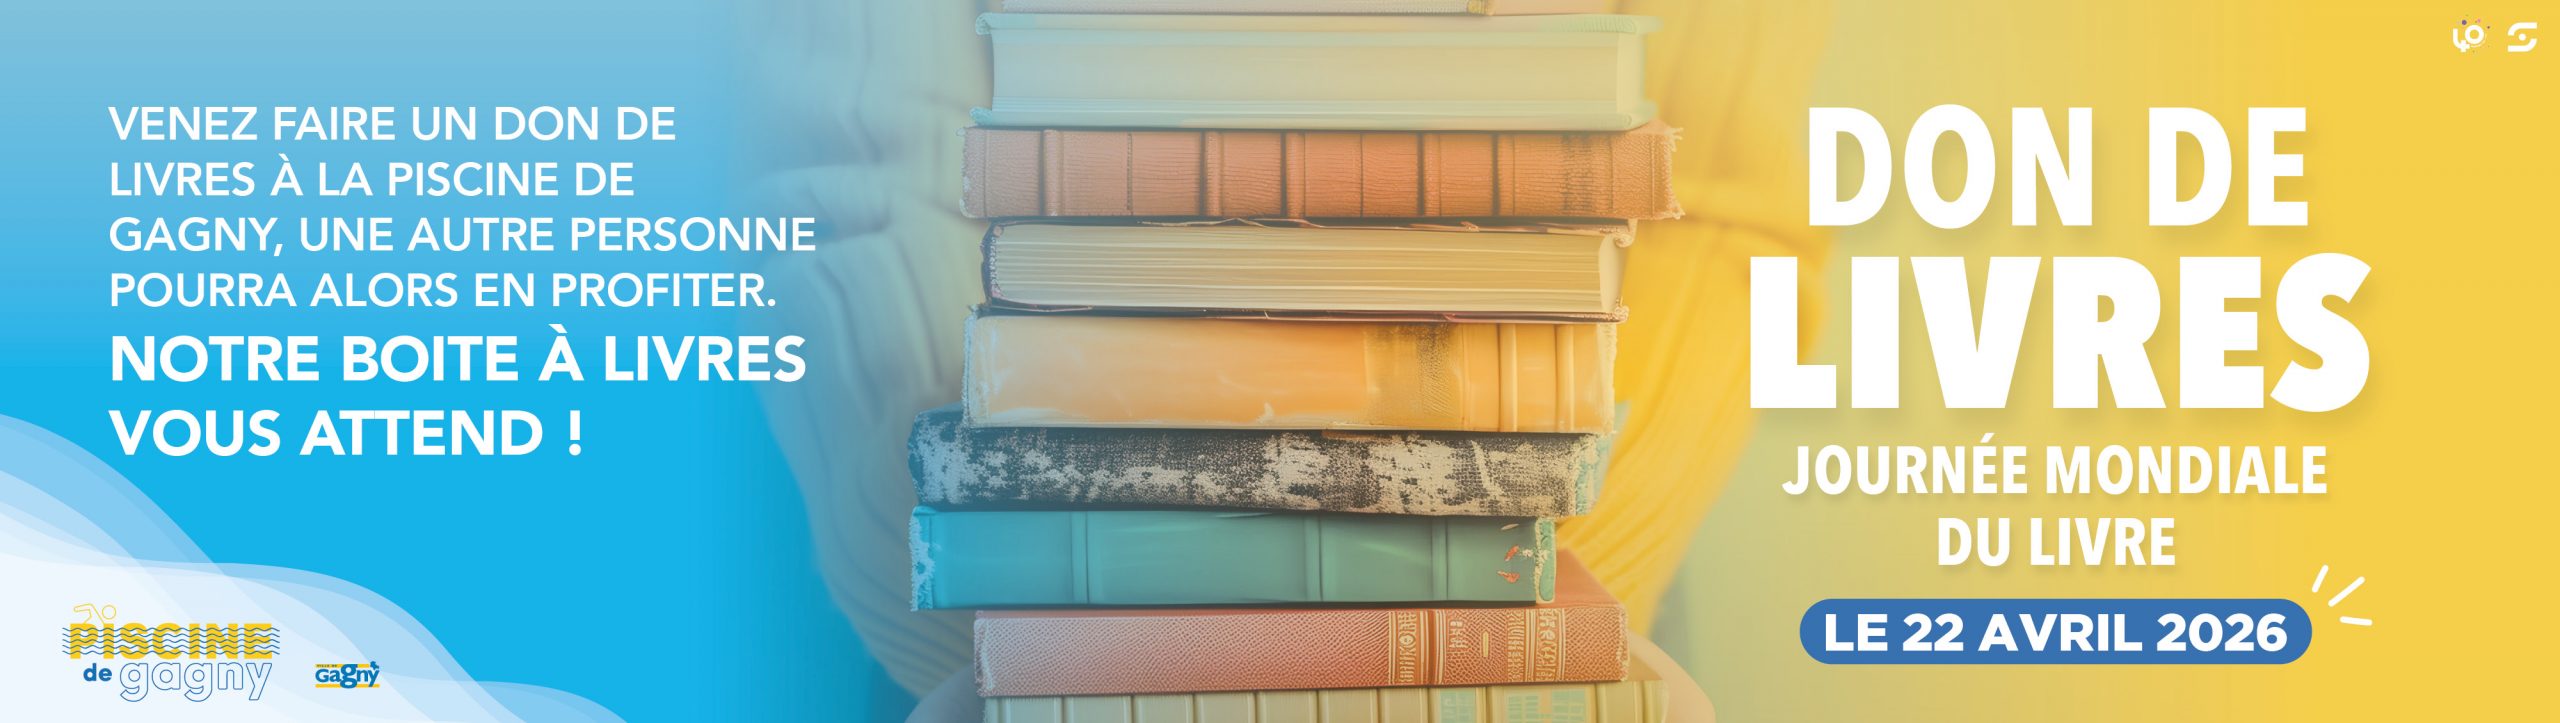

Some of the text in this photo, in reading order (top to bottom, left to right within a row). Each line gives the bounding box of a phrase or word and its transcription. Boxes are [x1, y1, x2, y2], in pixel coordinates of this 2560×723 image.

[108, 105, 676, 141] VENEZ FAIRE UN DON DE
[111, 153, 634, 197] LIVRES À LA PISCINE DE
[1809, 104, 2308, 229] DON DE
[109, 216, 816, 257] GAGNY, UNE AUTRE PERSONNE
[111, 272, 776, 307] POURRA ALORS EN PROFITER.
[112, 323, 806, 383] NOTRE BOITE À LIVRES
[1750, 253, 2370, 412] LIVRES
[108, 409, 581, 457] VOUS ATTEND !
[1782, 432, 2327, 495] JOURNÉE MONDIALE
[1938, 517, 2175, 566] DU LIVRE
[70, 623, 272, 659] PISCINE
[1825, 613, 2287, 652] LE 22 AVRIL 2026
[83, 662, 273, 702] de gagny
[315, 663, 379, 689] Gagny
